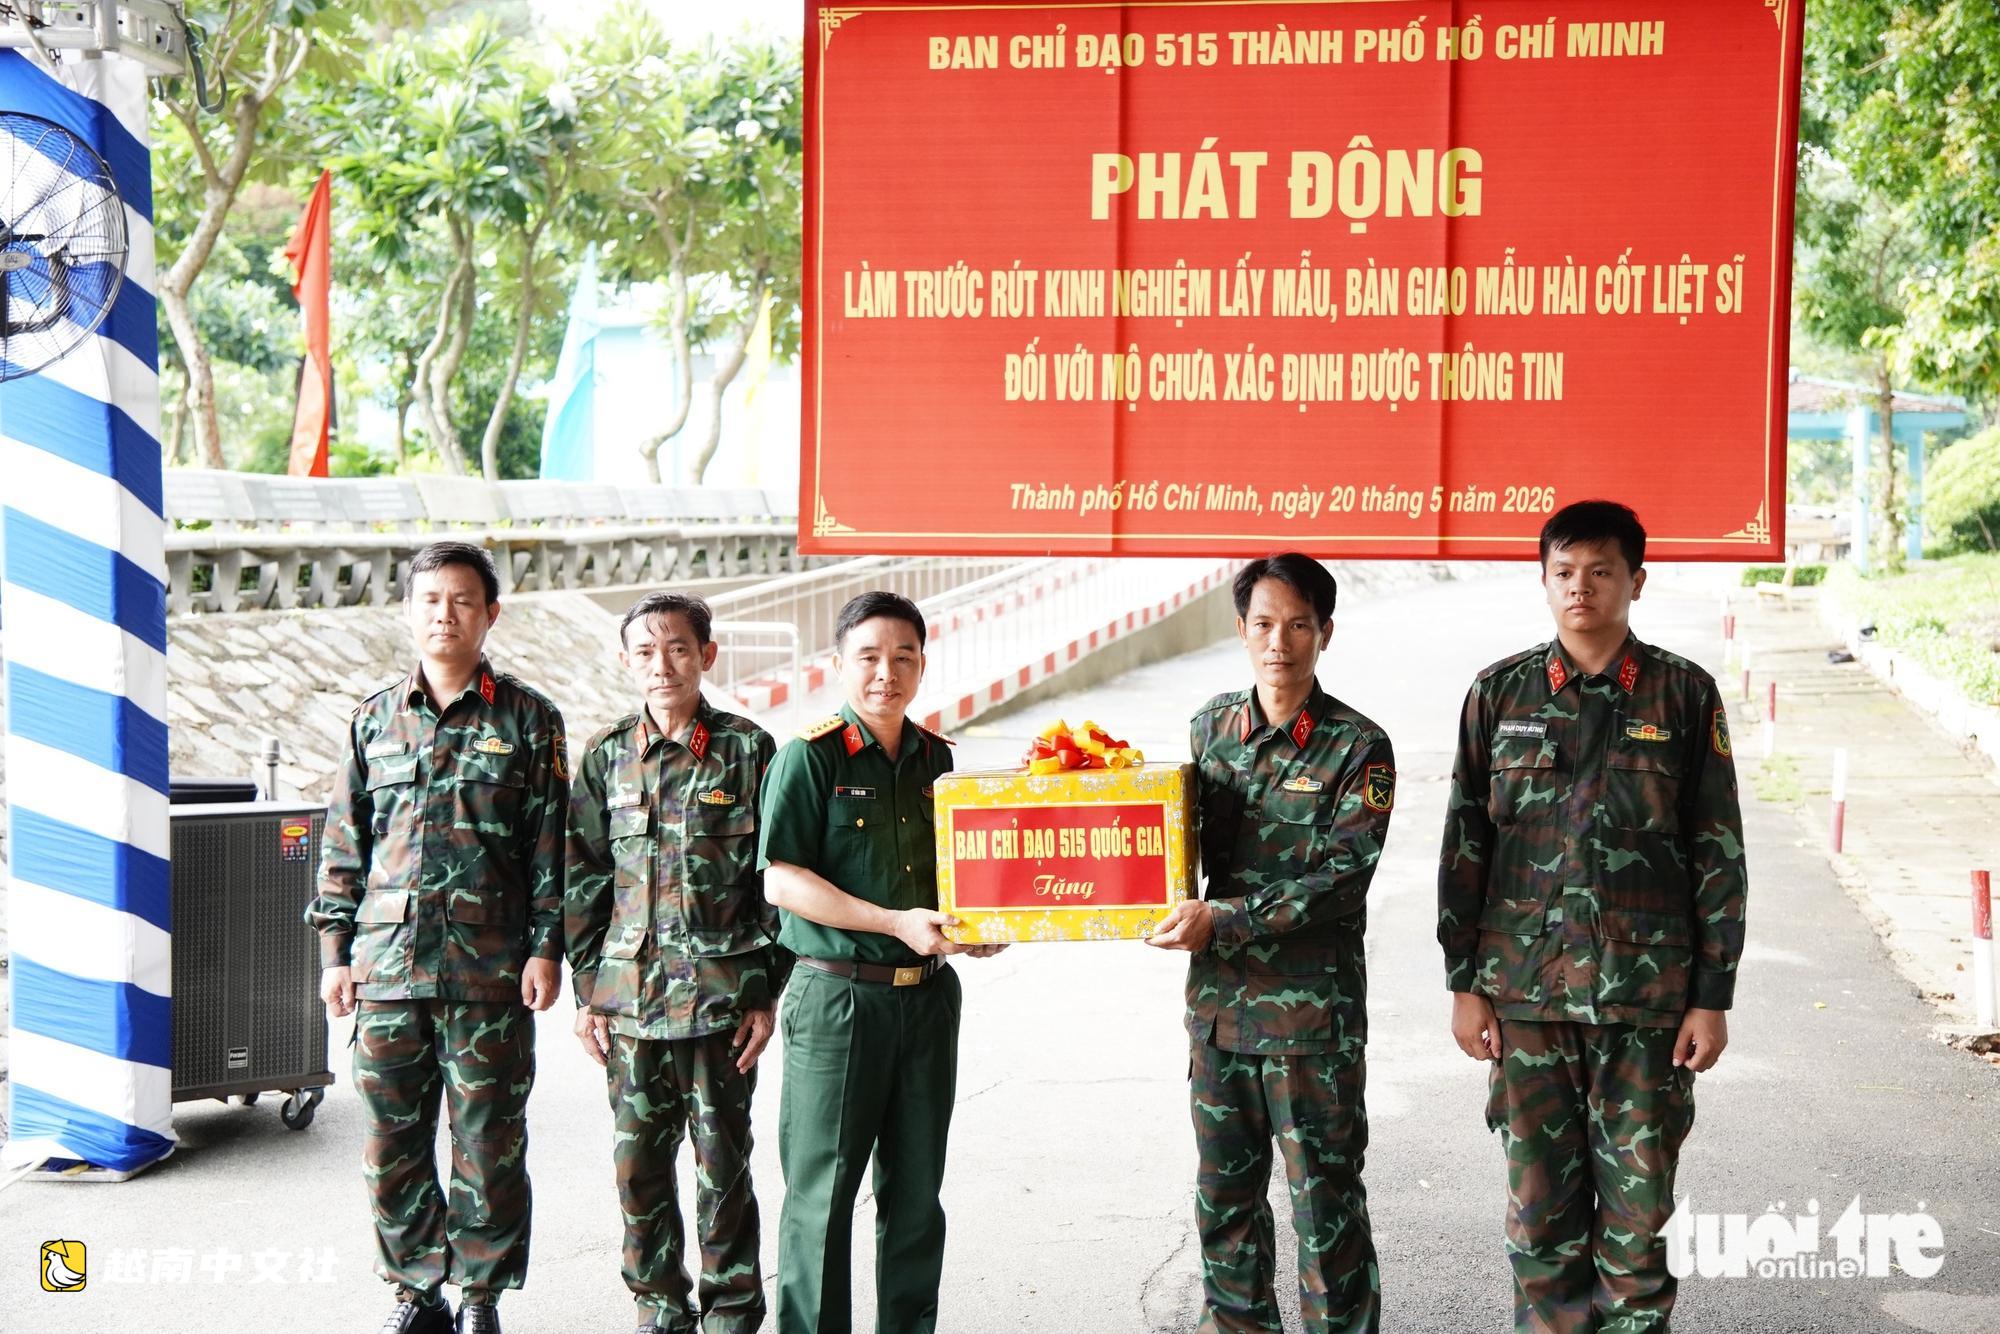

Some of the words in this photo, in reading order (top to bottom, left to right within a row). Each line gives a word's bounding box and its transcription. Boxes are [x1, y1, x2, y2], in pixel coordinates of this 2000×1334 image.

[929, 36, 998, 69] BAN
[1010, 24, 1066, 68] CHỈ
[1076, 33, 1144, 74] ĐẠO
[1156, 33, 1217, 66] 515
[1229, 24, 1342, 64] THÀNH
[1355, 16, 1426, 63] PHỐ
[1437, 15, 1483, 60] HỒ
[1496, 17, 1555, 59] CHÍ
[1567, 21, 1664, 57] MINH
[1091, 137, 1268, 220] PHÁT
[1288, 135, 1482, 233] ĐỘNG
[845, 261, 897, 318] LÀM
[904, 260, 983, 318] TRƯỚC
[991, 260, 1038, 318] RÚT
[1045, 270, 1105, 317] KINH
[1112, 259, 1211, 327] NGHIỆM
[1219, 252, 1265, 316] LẤY
[1273, 250, 1337, 322] MẪU,
[1346, 258, 1399, 316] BÀN
[1407, 267, 1466, 316] GIAO
[1476, 248, 1534, 315] MẪU
[1543, 256, 1586, 314] HÀI
[1596, 248, 1646, 314] CỐT
[1654, 254, 1708, 324] LIỆT
[1716, 255, 1745, 313] SĨ
[1004, 337, 1046, 401] ĐỐI
[1054, 343, 1094, 401] VỚI
[1101, 343, 1141, 411] MỘ
[1149, 349, 1216, 401] CHƯA
[1223, 343, 1274, 401] XÁC
[1282, 354, 1343, 412] ĐỊNH
[1351, 348, 1420, 411] ĐƯỢC
[1428, 342, 1513, 401] THÔNG
[1522, 353, 1563, 400] TIN
[1011, 483, 1075, 510] Thành
[1080, 480, 1126, 516] phố
[1128, 483, 1158, 510] Hồ
[1164, 484, 1199, 511] Chí
[1206, 485, 1263, 516] Minh,
[1270, 485, 1324, 519] ngày
[1329, 486, 1356, 512] 20
[1362, 485, 1423, 518] tháng
[1430, 486, 1443, 512] 5
[1449, 486, 1497, 512] năm
[1503, 486, 1556, 513] 2026
[955, 829, 986, 860] BAN
[992, 818, 1018, 860] CHỈ
[1024, 828, 1054, 866] ĐẠO
[1060, 827, 1086, 859] 515
[1091, 816, 1132, 861] QUỐC
[1137, 826, 1164, 857] GIA
[1033, 874, 1095, 901] Tặng
